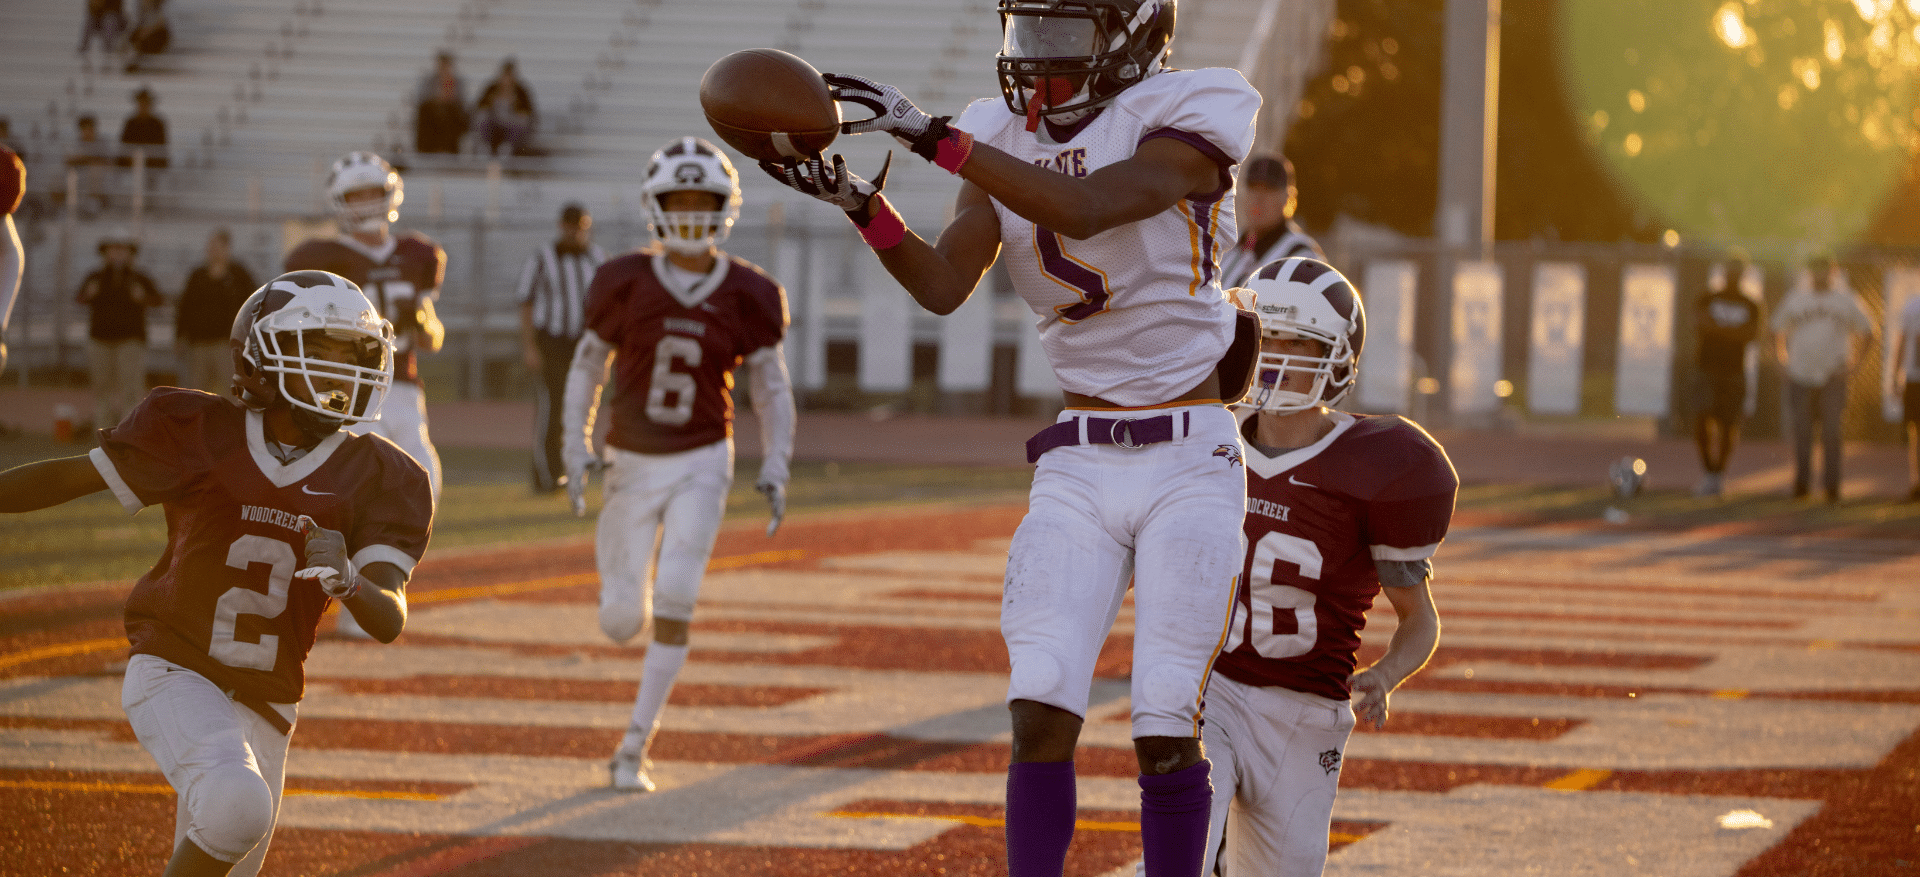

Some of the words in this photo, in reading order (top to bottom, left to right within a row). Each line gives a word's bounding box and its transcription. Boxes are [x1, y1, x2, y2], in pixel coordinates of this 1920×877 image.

[1033, 223, 1113, 325] 5
[645, 334, 703, 425] 6
[208, 534, 297, 672] 2
